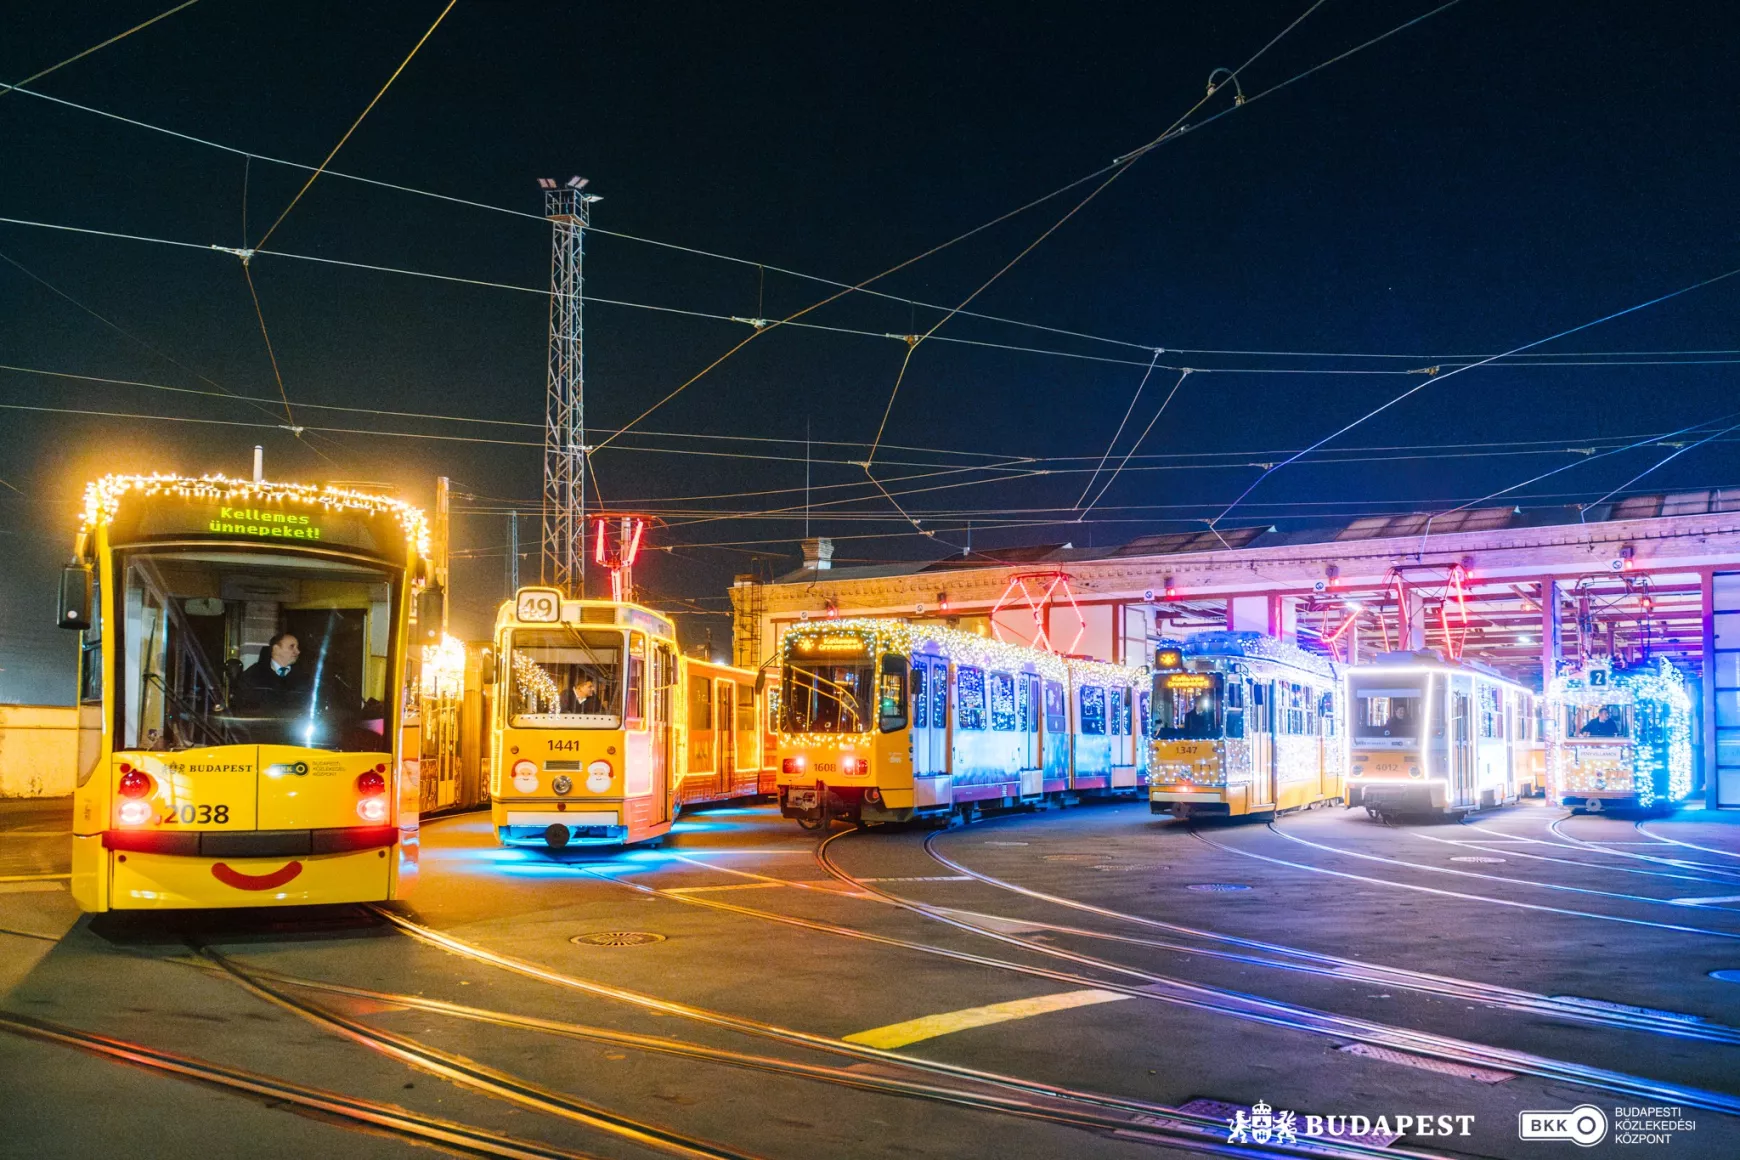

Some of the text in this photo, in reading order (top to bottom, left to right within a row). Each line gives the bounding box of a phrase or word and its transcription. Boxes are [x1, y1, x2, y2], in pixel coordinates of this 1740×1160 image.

[221, 507, 310, 524] Kellemes
[209, 520, 320, 539] ünnepeket!
[523, 598, 552, 617] 49
[1595, 672, 1603, 685] 2
[547, 740, 579, 751] 1441
[1176, 746, 1198, 755] 1347
[189, 764, 253, 773] BUDAPEST
[814, 763, 837, 772] 1608
[1375, 764, 1399, 772] 4012
[164, 804, 230, 824] 2038
